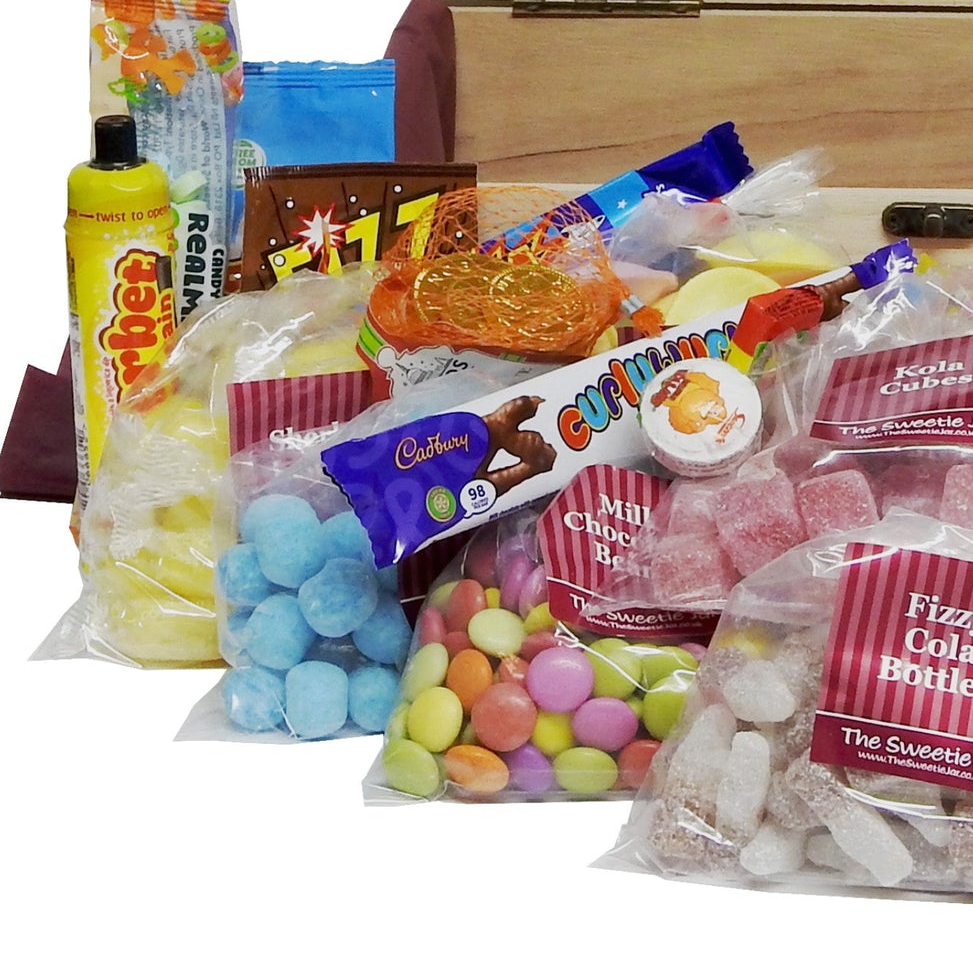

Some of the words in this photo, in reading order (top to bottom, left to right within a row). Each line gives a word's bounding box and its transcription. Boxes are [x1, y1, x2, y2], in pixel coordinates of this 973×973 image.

[96, 211, 126, 223] twist
[131, 210, 144, 221] to
[210, 248, 225, 299] CANDY
[107, 258, 158, 387] rbet
[893, 359, 965, 380] Kola
[879, 372, 973, 396] Cubes
[839, 425, 877, 436] The
[881, 415, 964, 432] Sweetie
[394, 432, 470, 470] Cadbury
[468, 485, 486, 501] 98
[606, 610, 684, 625] Sweetie
[841, 726, 882, 750] The
[885, 736, 972, 767] Sweetie
